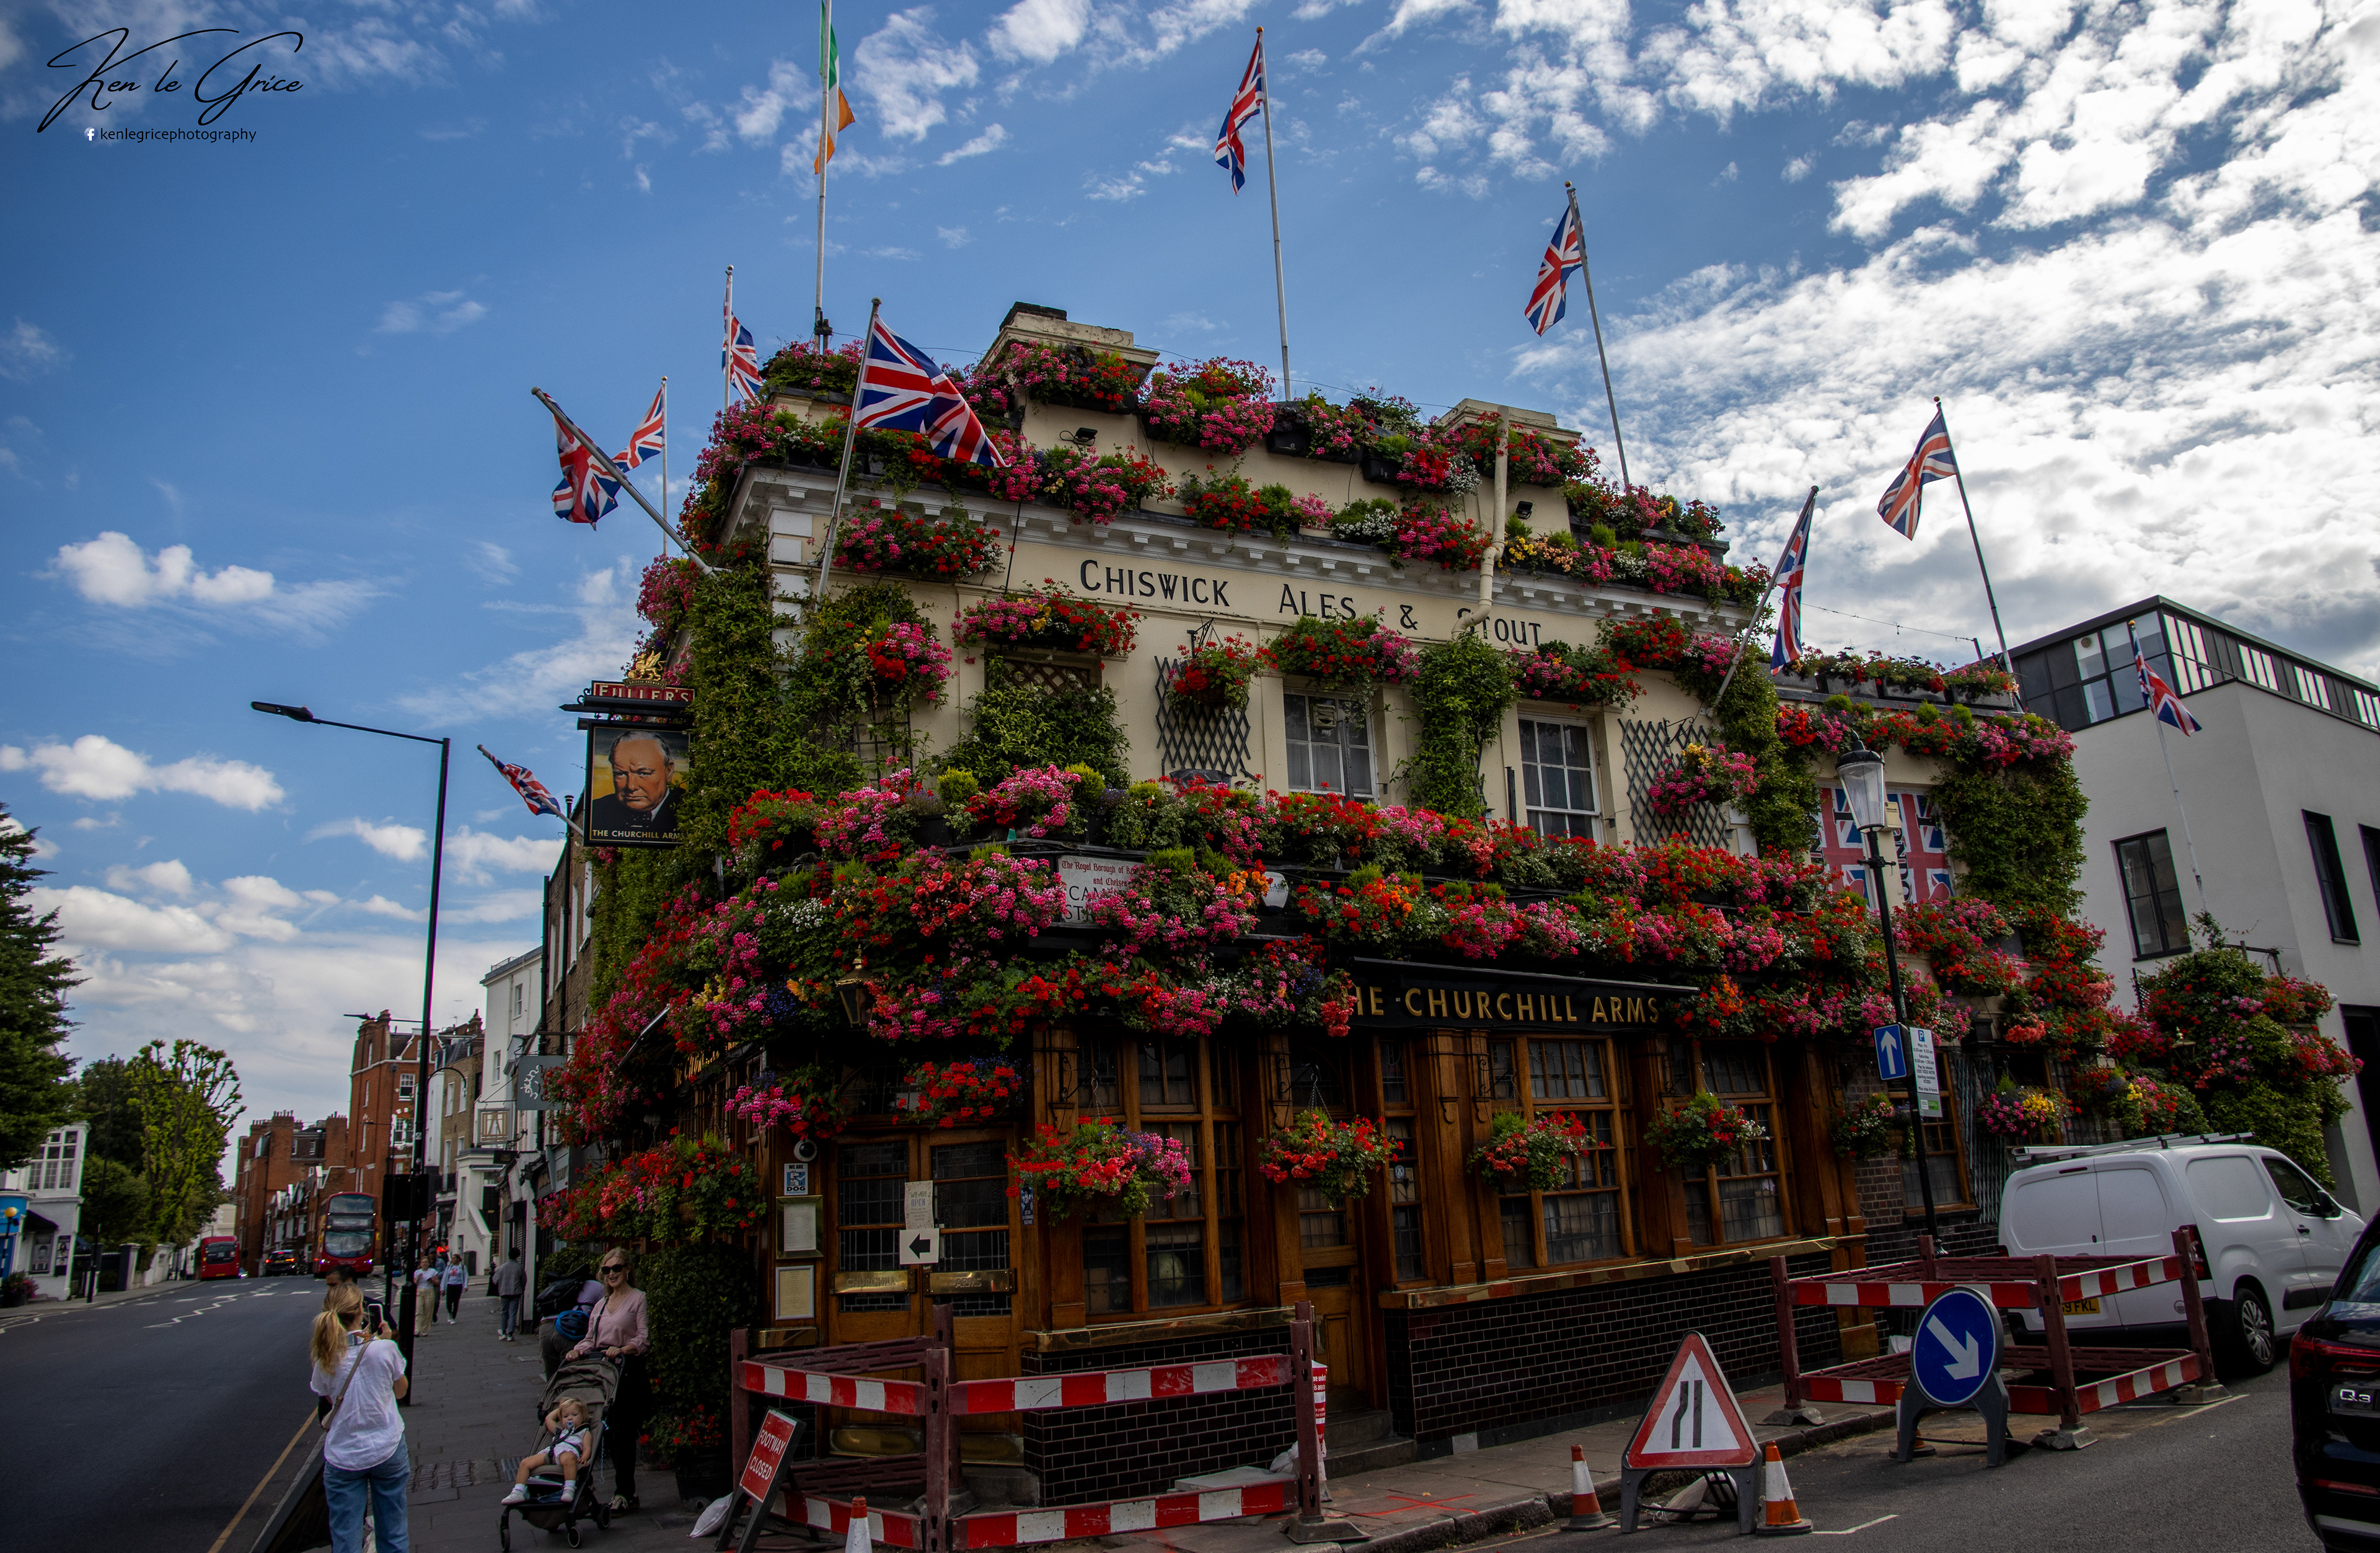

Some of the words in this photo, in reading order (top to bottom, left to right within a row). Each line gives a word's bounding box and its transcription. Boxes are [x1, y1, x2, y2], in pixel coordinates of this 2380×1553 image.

[1080, 560, 1230, 607] CHISWICK
[1279, 583, 1356, 620] ALES
[1399, 604, 1417, 630] &
[611, 830, 659, 838] CHURCHILL
[1062, 861, 1073, 869] The
[1074, 861, 1091, 873] Royal
[1093, 863, 1116, 875] Borough
[1093, 877, 1103, 885] and
[1106, 878, 1127, 887] Chelsea
[1404, 988, 1577, 1022] CHURCHILL
[1590, 996, 1660, 1024] ARMS
[911, 1198, 925, 1207] OPEN
[2074, 1300, 2096, 1312] FKL
[2339, 1389, 2371, 1403] Q3
[758, 1429, 786, 1455] FOOTWAY
[749, 1456, 772, 1480] CLOSED
